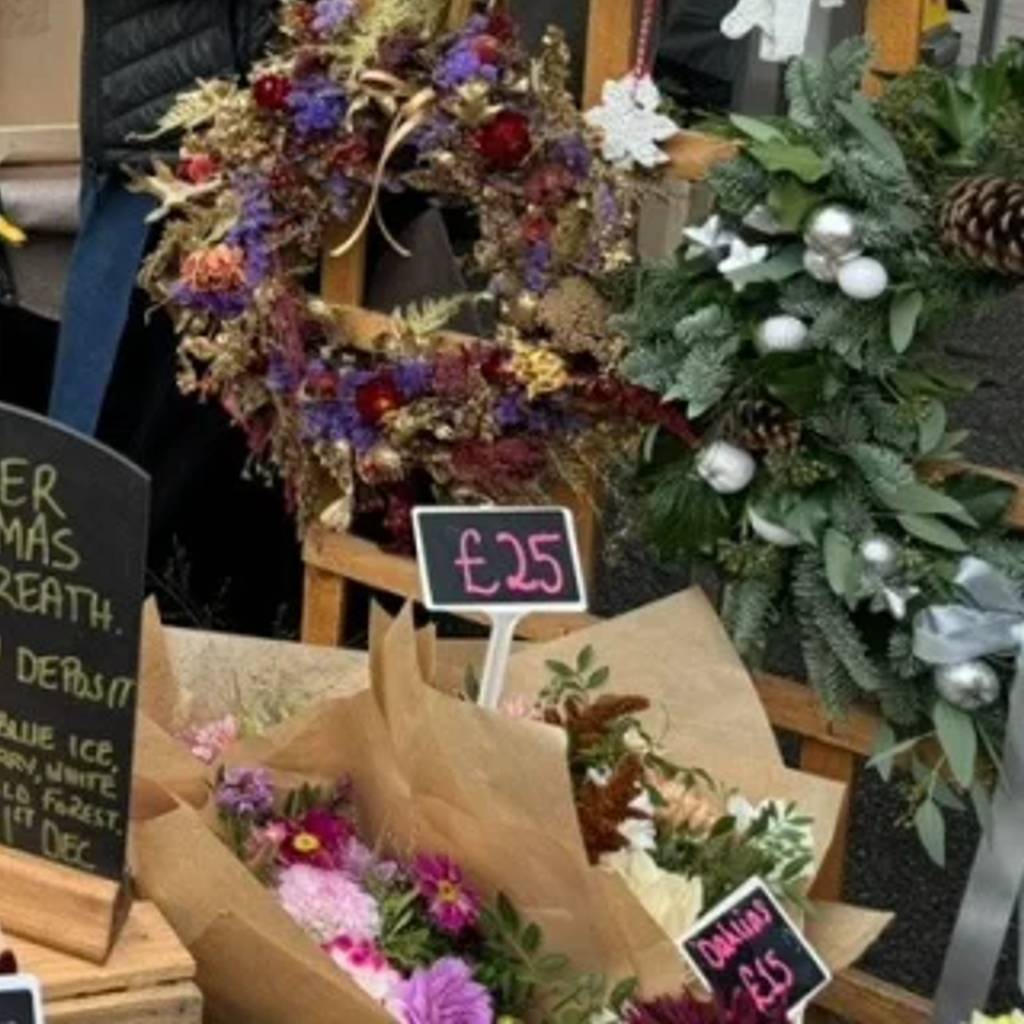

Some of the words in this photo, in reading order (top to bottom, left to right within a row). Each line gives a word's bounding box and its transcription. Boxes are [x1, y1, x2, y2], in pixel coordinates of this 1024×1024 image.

[455, 527, 566, 598] £25
[16, 646, 136, 709] DEPOSIT
[46, 761, 118, 800] WHITE
[41, 819, 96, 870] DEC
[738, 947, 794, 1016] £15
